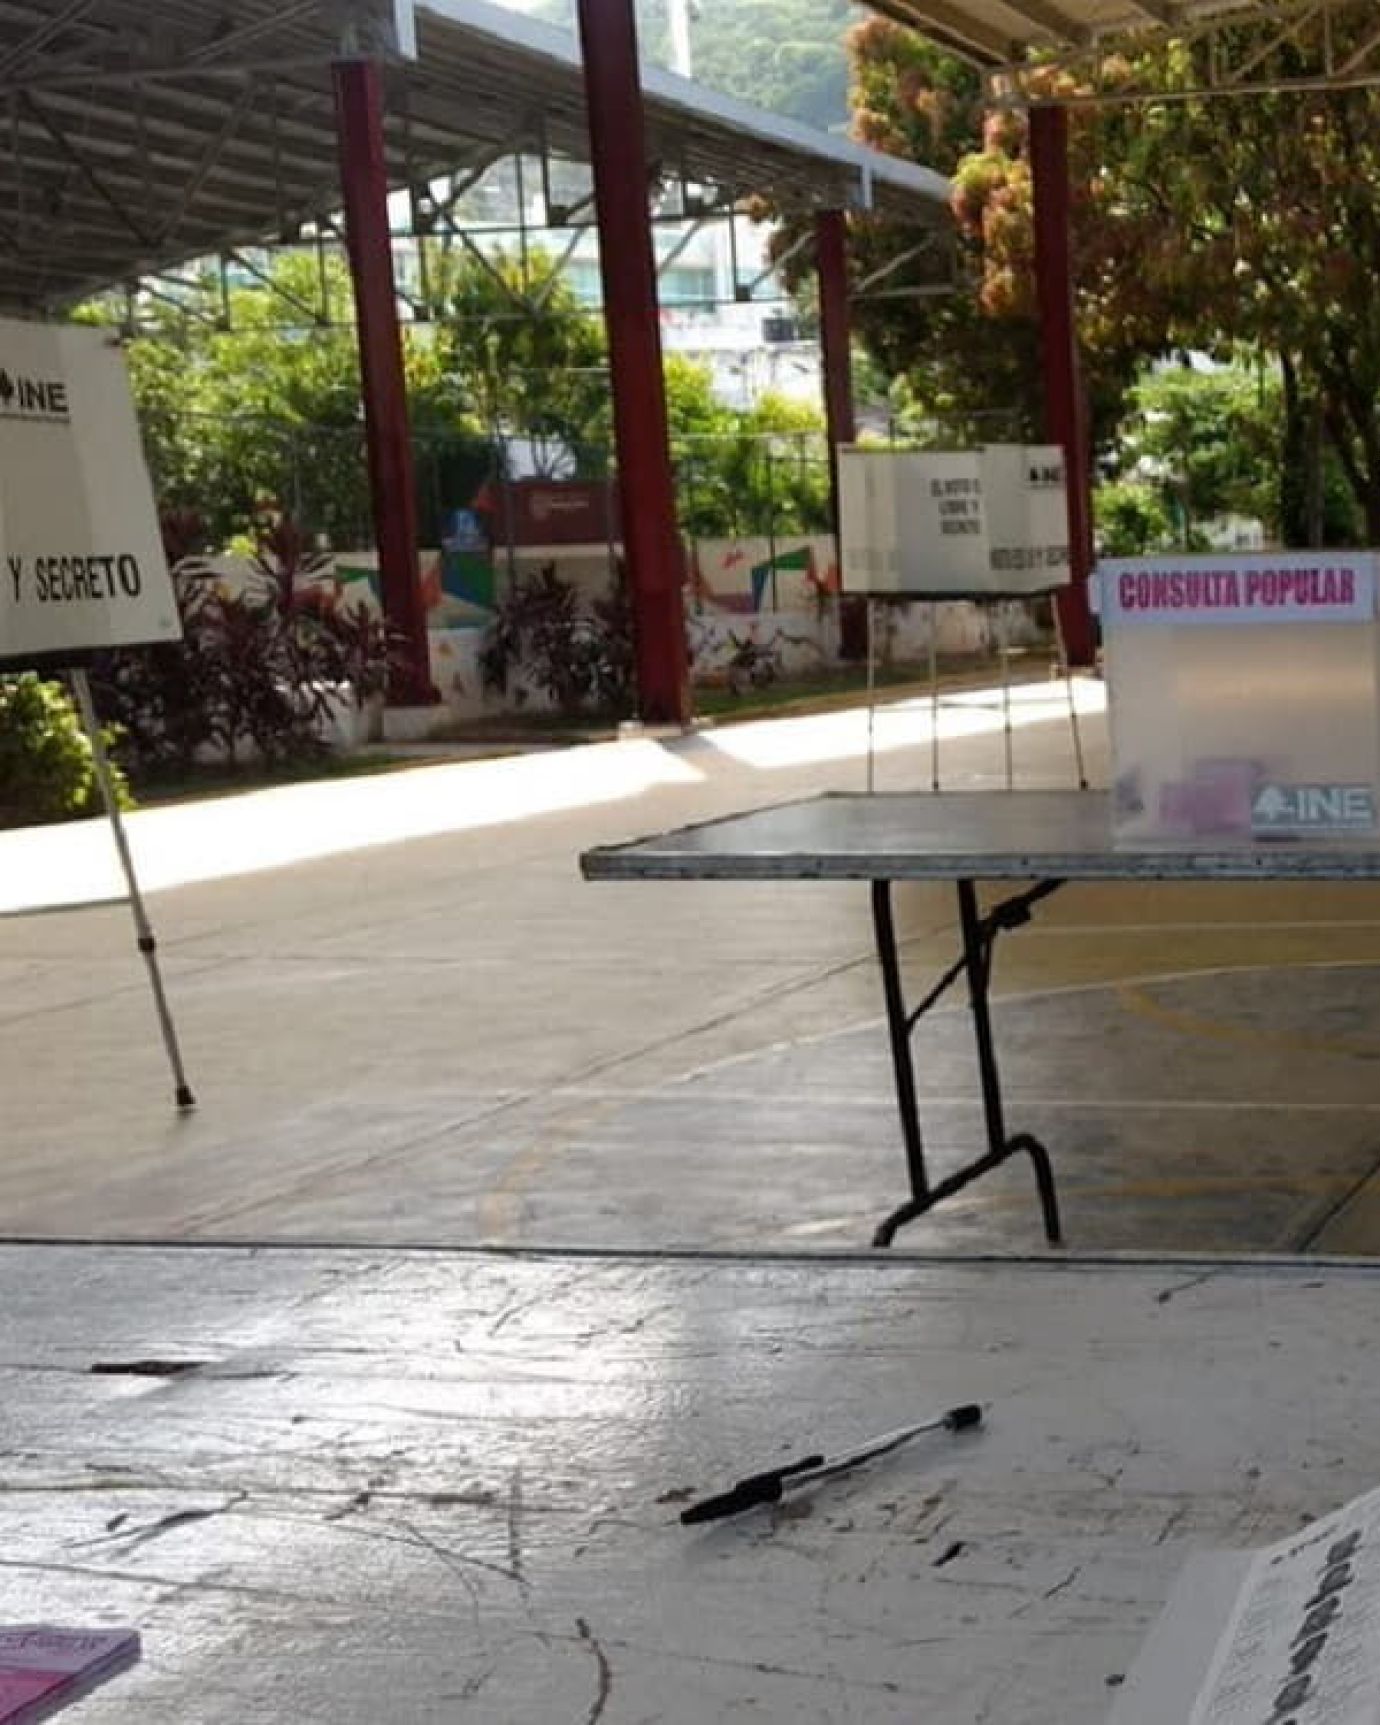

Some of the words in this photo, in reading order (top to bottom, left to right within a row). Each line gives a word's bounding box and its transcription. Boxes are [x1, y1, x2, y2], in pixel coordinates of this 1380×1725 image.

[18, 378, 69, 412] INE
[7, 556, 21, 602] Y
[36, 554, 141, 602] SECRETO
[1119, 570, 1240, 611] CONSULTA
[1245, 567, 1355, 606] POPULAR
[1297, 788, 1370, 820] INE
